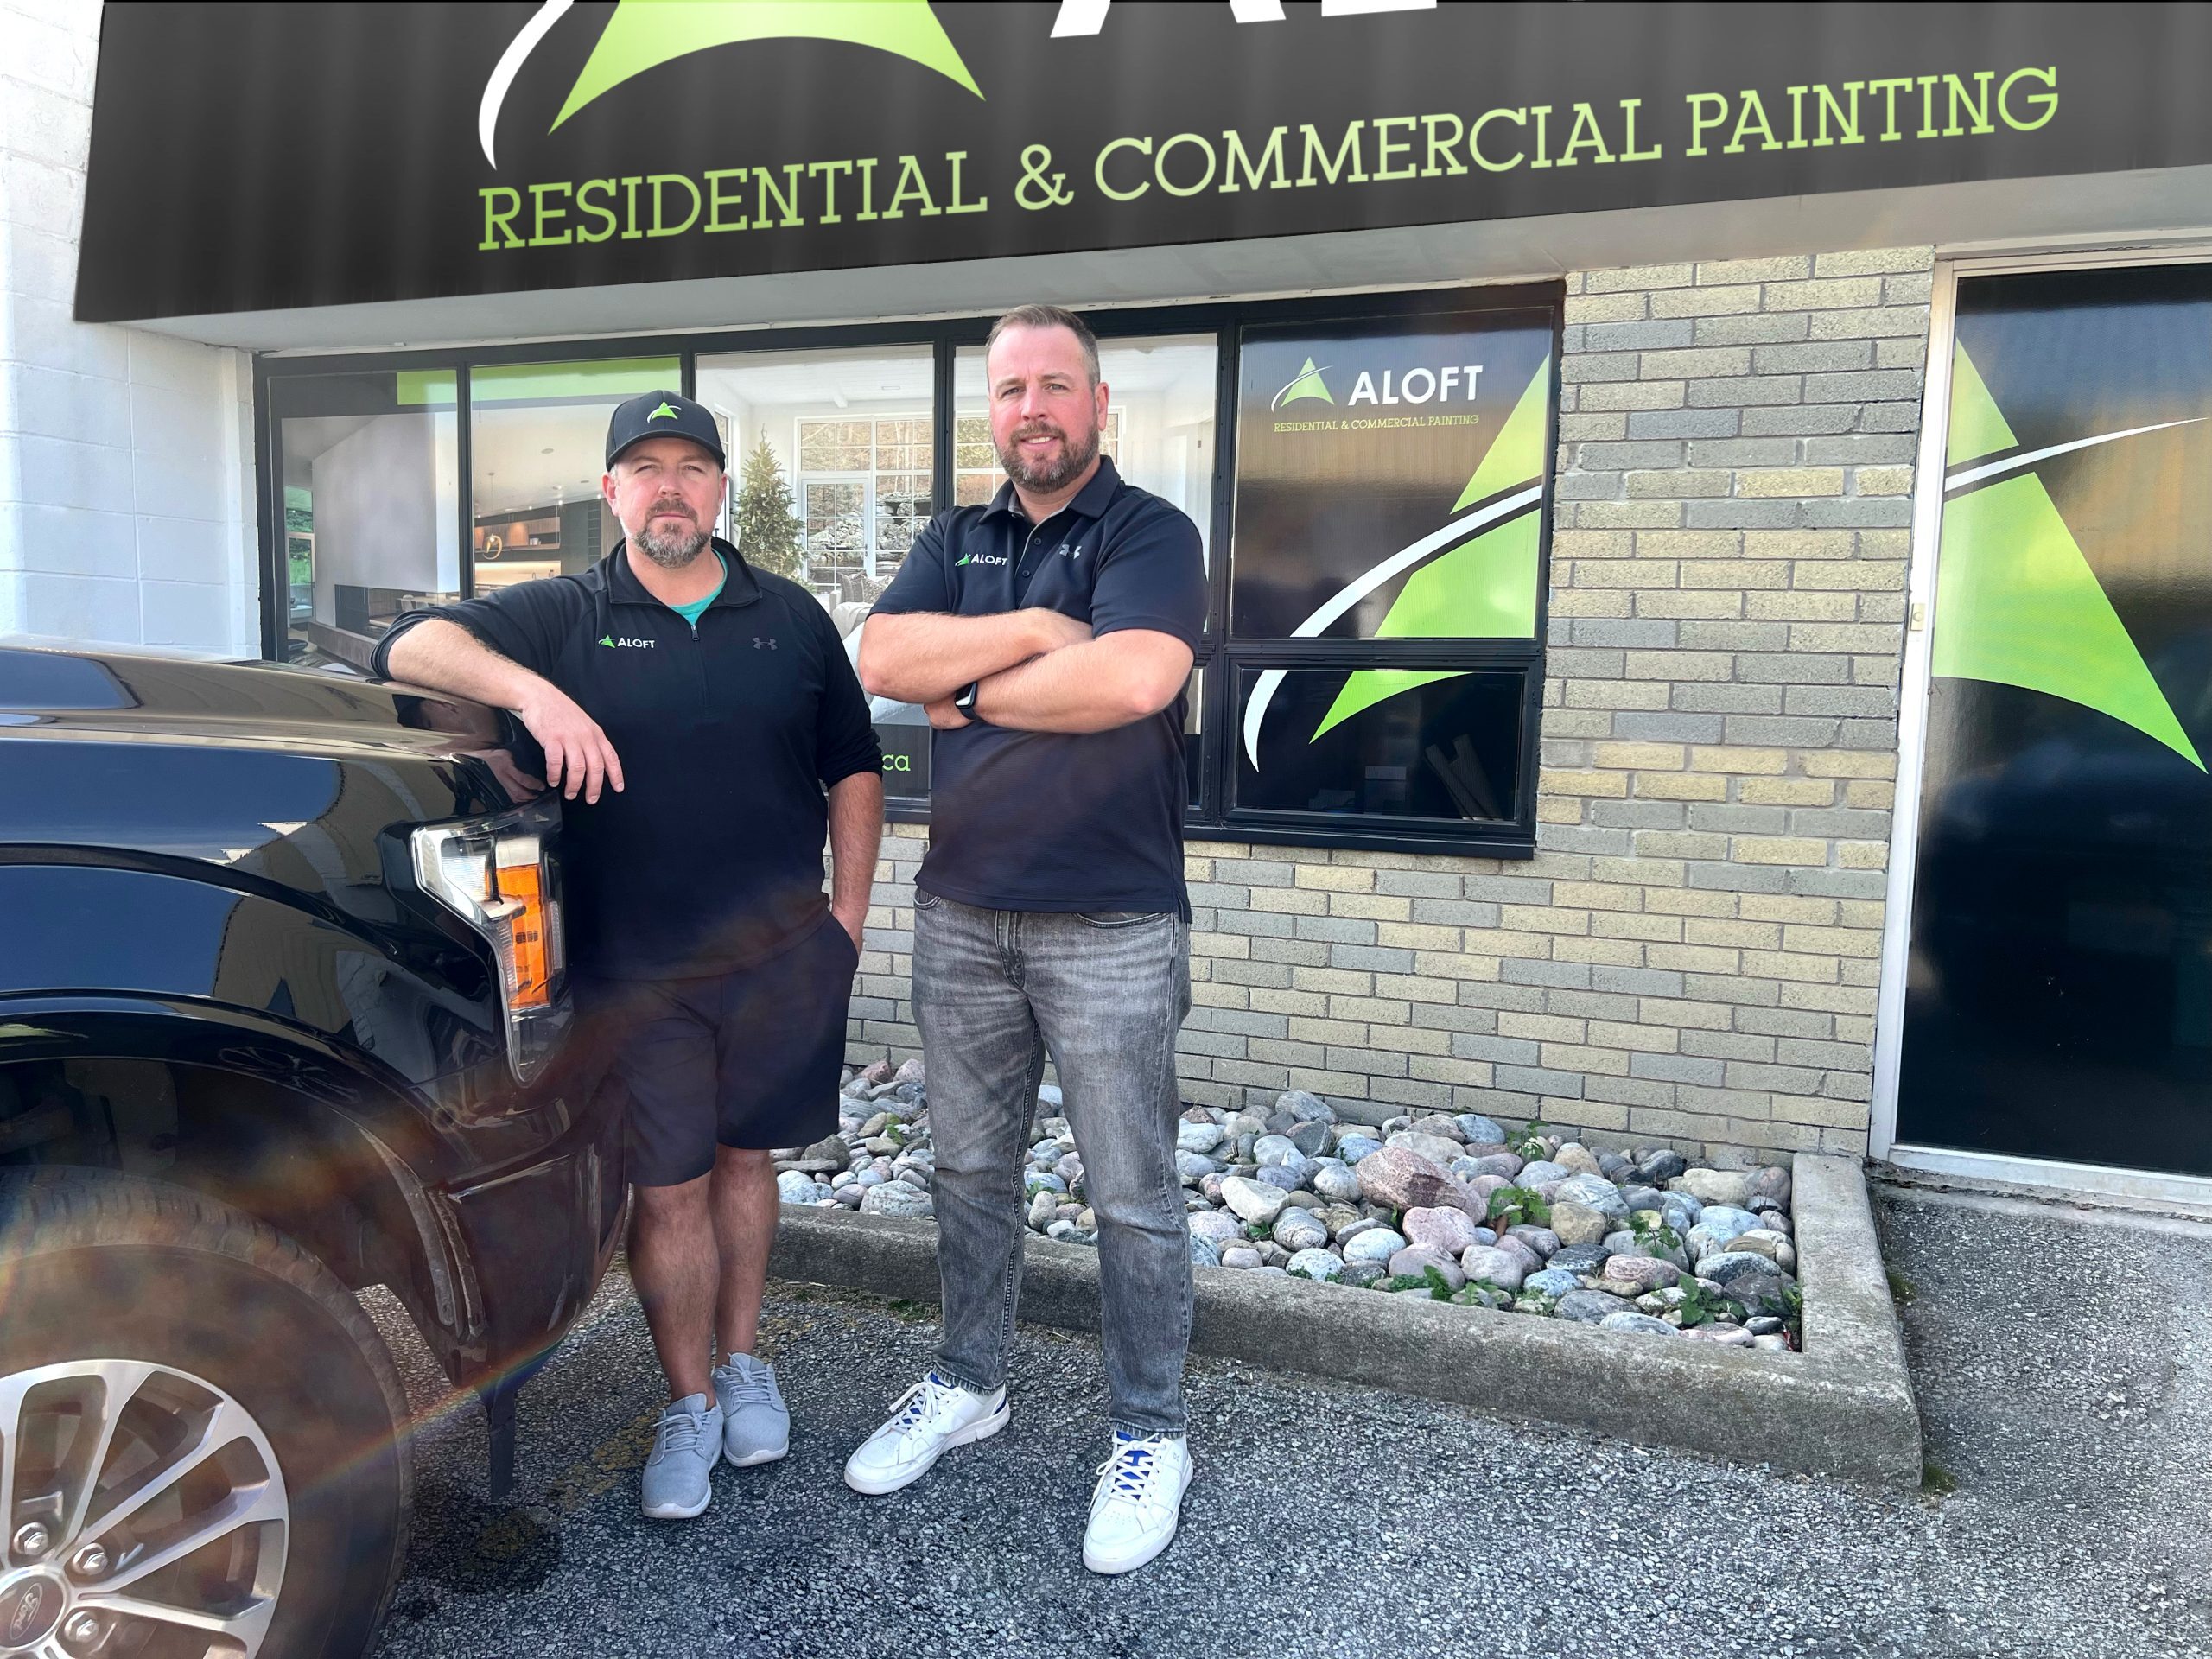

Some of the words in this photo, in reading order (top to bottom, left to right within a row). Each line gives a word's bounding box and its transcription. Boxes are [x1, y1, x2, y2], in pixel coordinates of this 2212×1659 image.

[478, 150, 988, 251] RESIDENTIAL
[1014, 143, 1075, 211] &
[1095, 98, 1662, 201] COMMERCIAL
[1685, 66, 2060, 158] PAINTING
[1347, 365, 1484, 406] ALOFT
[1274, 421, 1338, 432] RESIDENTIAL
[1341, 420, 1349, 429] &
[1351, 416, 1426, 429] COMMERCIAL
[1428, 415, 1479, 426] PAINTING
[970, 553, 1008, 566] ALOFT
[617, 637, 655, 649] ALOFT
[13, 1592, 39, 1631] Ford
